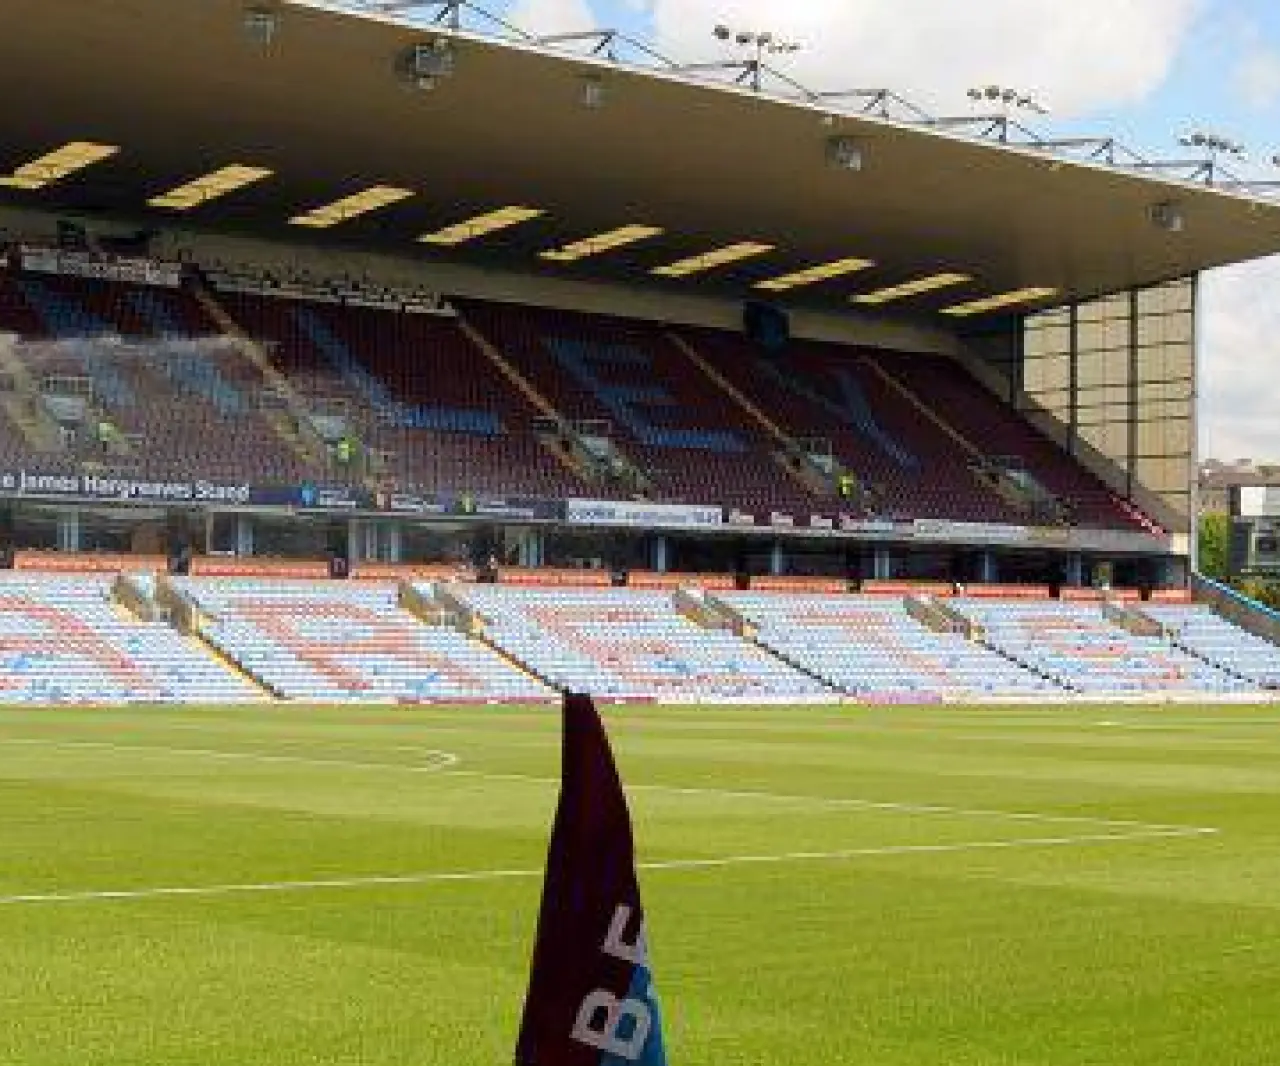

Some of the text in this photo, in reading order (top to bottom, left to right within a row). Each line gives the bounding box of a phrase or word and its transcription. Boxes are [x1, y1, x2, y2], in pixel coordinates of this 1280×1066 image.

[17, 468, 79, 497] James
[84, 475, 194, 500] Hargreaves
[195, 480, 250, 502] Stand
